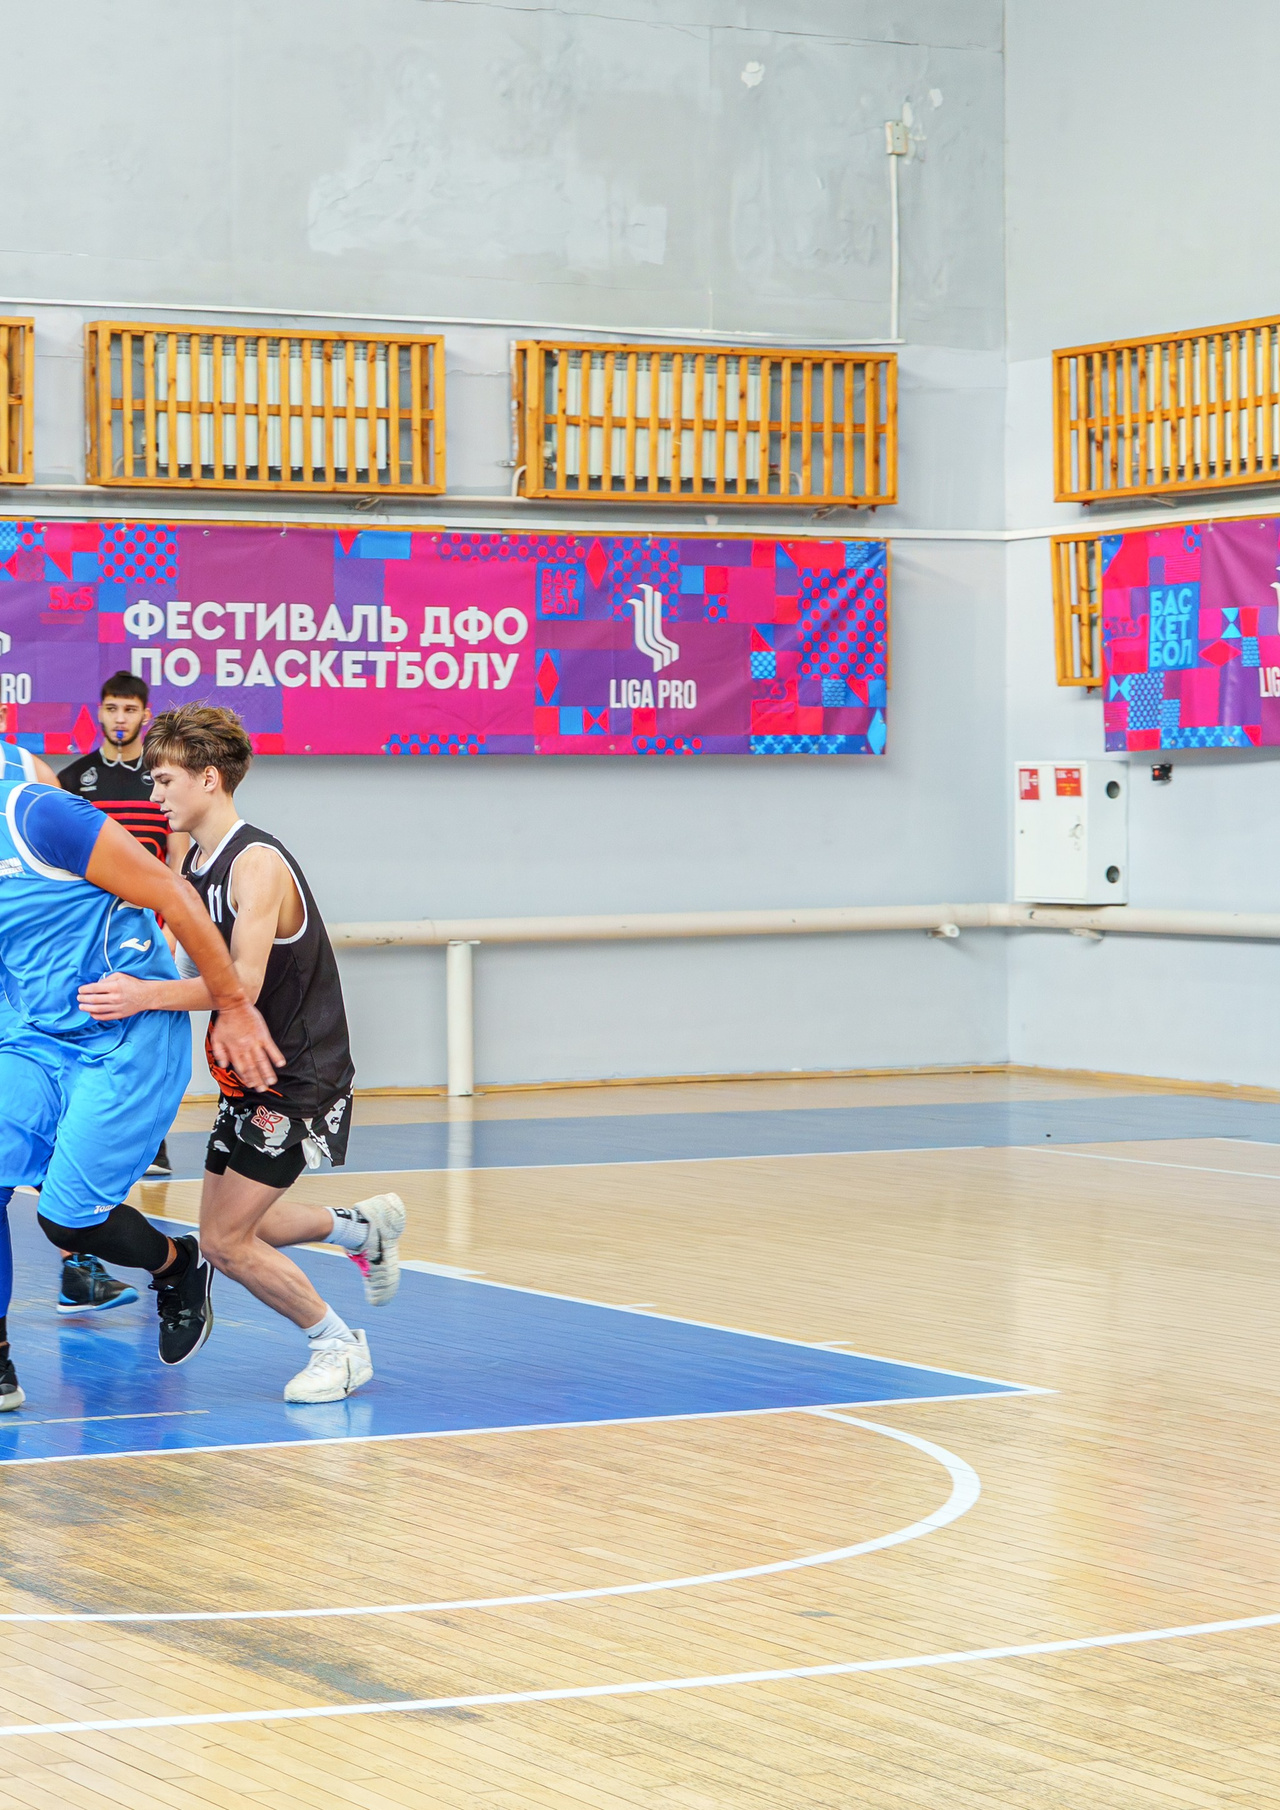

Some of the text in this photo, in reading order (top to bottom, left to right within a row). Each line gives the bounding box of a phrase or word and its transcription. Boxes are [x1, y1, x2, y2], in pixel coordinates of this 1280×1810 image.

[1150, 588, 1193, 616] БАС
[122, 600, 529, 647] ФЕСТИВАЛЬ ДФО
[1150, 614, 1190, 641] КЕТ
[130, 647, 520, 690] ПО БАСКЕТБОЛУ
[1150, 639, 1193, 668] БОЛ
[0, 673, 32, 704] RO
[609, 679, 697, 709] LIGA PRO
[207, 883, 222, 923] 11
